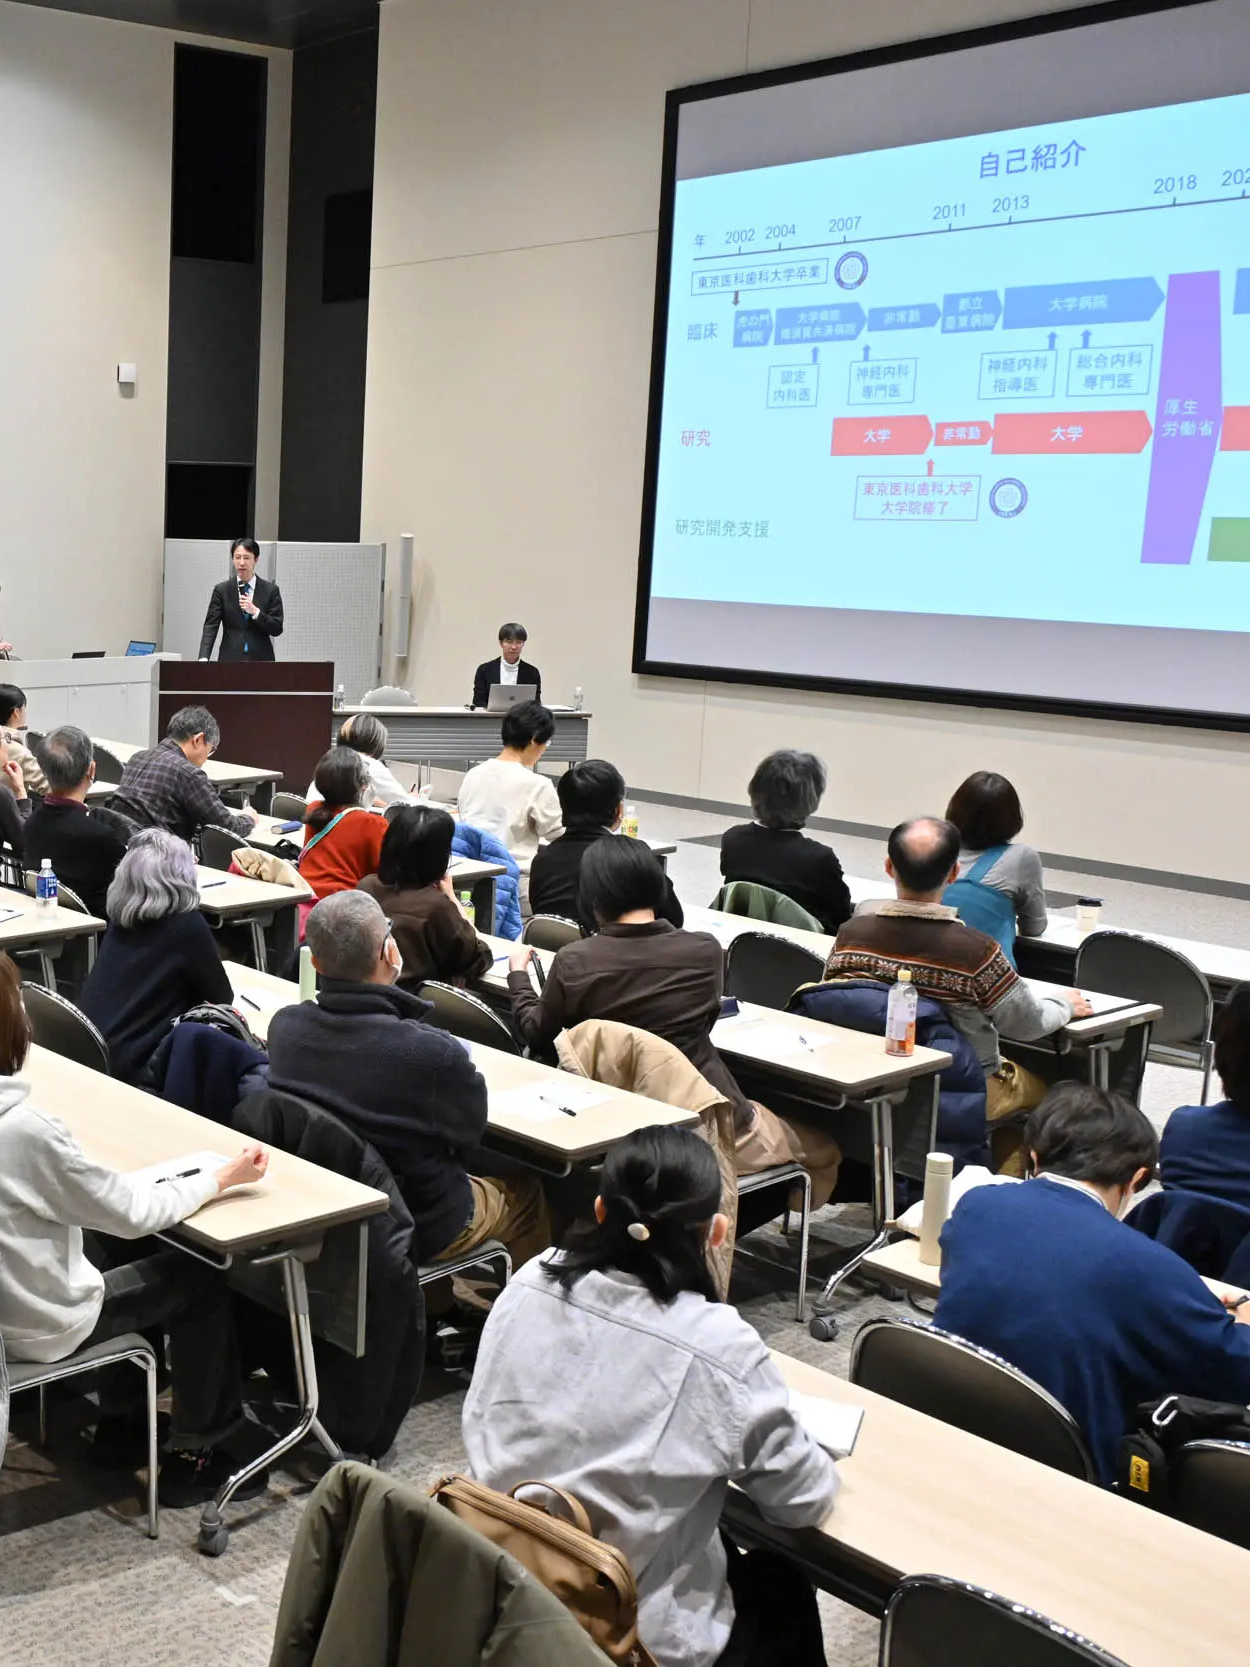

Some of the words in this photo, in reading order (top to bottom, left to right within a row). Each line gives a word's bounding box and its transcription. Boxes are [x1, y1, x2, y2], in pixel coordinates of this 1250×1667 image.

[980, 140, 1086, 178] 自己紹介
[694, 234, 705, 248] 年
[725, 228, 755, 244] 2002
[765, 224, 796, 239] 2004
[829, 215, 862, 232] 2007
[933, 203, 966, 220] 2011
[992, 195, 1030, 213] 2013
[1154, 174, 1197, 194] 2018
[697, 265, 820, 289] 東京医科歯科大学卒業
[1049, 294, 1109, 312] 大学病院
[687, 322, 719, 341] 臨床
[988, 356, 1048, 373] 神経内科
[1076, 351, 1143, 370] 総合内科
[780, 370, 806, 384] 認定
[856, 364, 909, 381] 神経内科
[1083, 372, 1134, 390] 専門医
[861, 383, 901, 399] 専門医
[993, 376, 1039, 393] 指導医
[773, 388, 811, 402] 内科医
[1164, 399, 1198, 415] 厚生
[863, 428, 891, 444] 大学
[942, 426, 982, 441] 非常勤
[1050, 425, 1084, 443] 大学
[1162, 420, 1215, 437] 労働省
[681, 428, 711, 447] 研究
[862, 481, 973, 497] 東京医科歯科大学
[881, 500, 949, 516] 大学院修了
[675, 519, 771, 538] 研究開発支援
